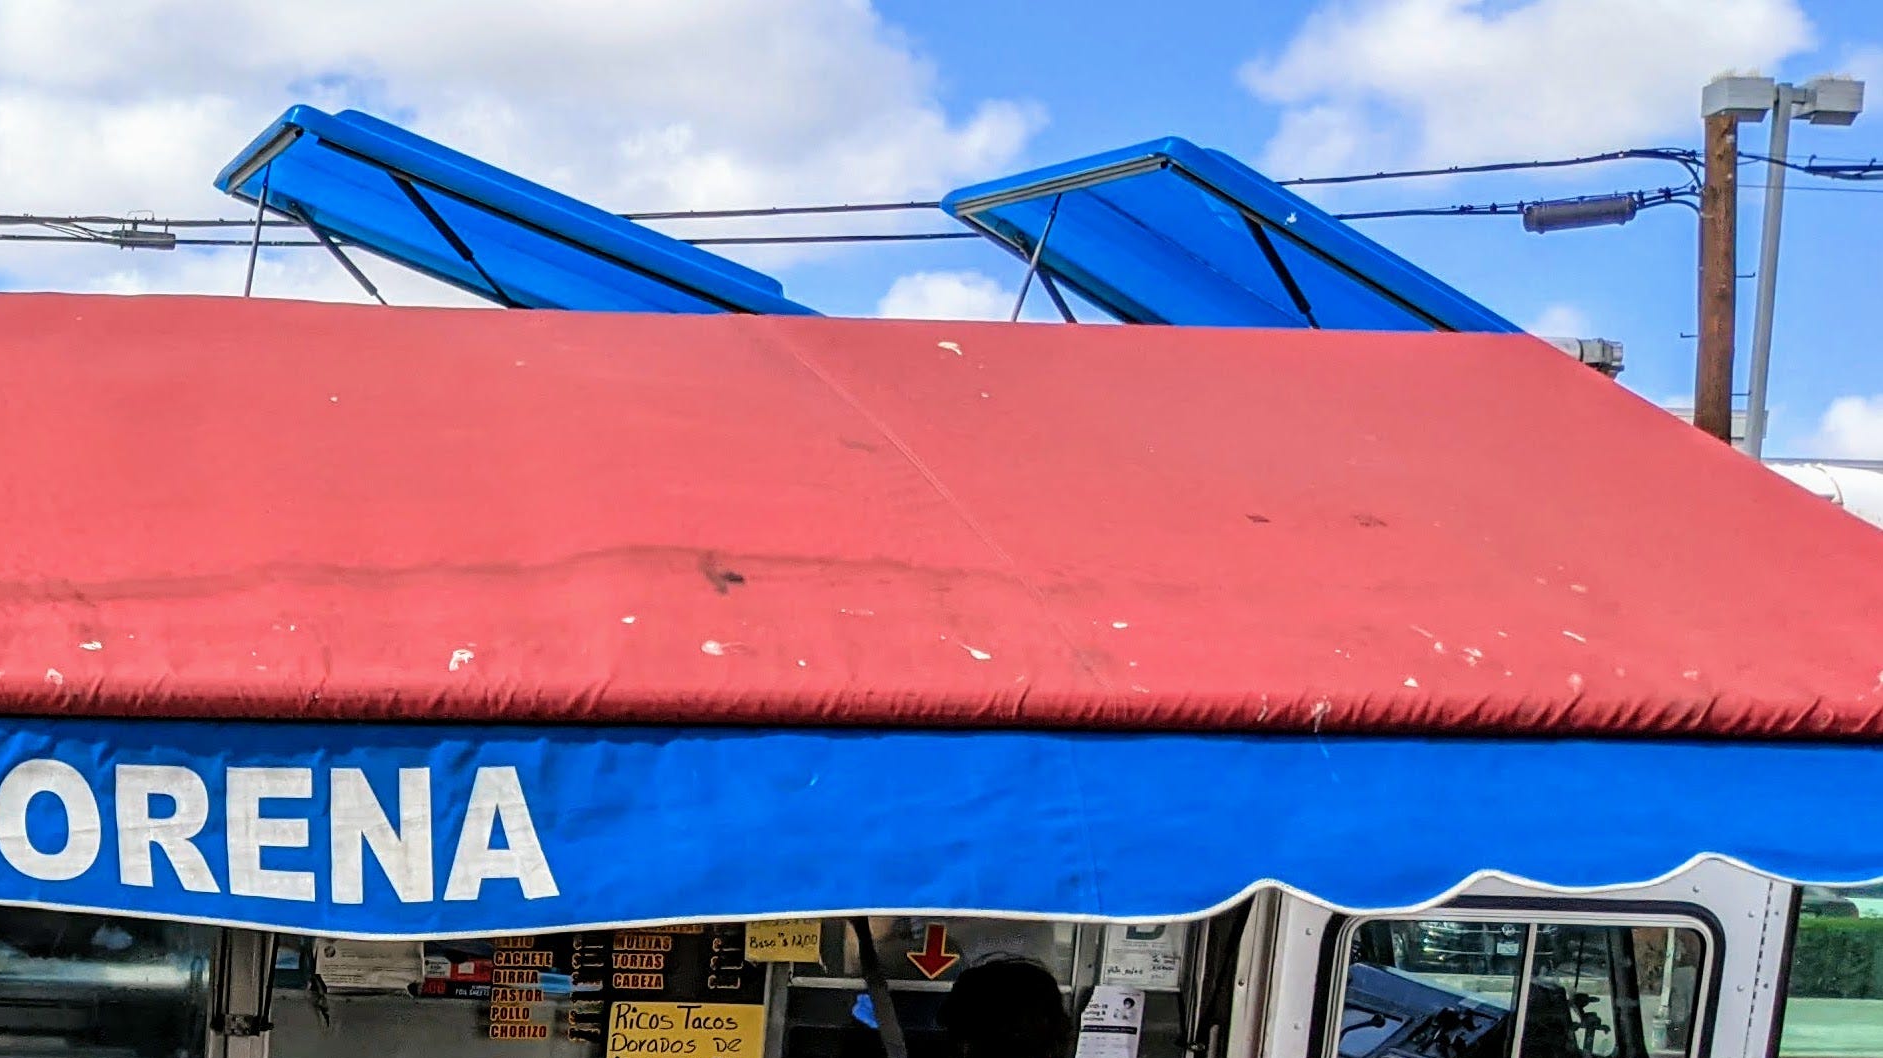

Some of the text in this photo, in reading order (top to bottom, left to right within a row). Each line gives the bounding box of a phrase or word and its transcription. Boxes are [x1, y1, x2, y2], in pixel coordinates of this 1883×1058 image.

[493, 951, 553, 968] CACHETE
[612, 953, 665, 969] TORTAS
[492, 970, 539, 985] BIRRIA
[612, 973, 664, 989] CABEZA
[491, 987, 543, 1002] PASTOR
[490, 1006, 530, 1022] POLLO
[615, 1003, 674, 1030] Ricos
[677, 1005, 738, 1030] Tacos
[489, 1025, 548, 1041] CHORIZO
